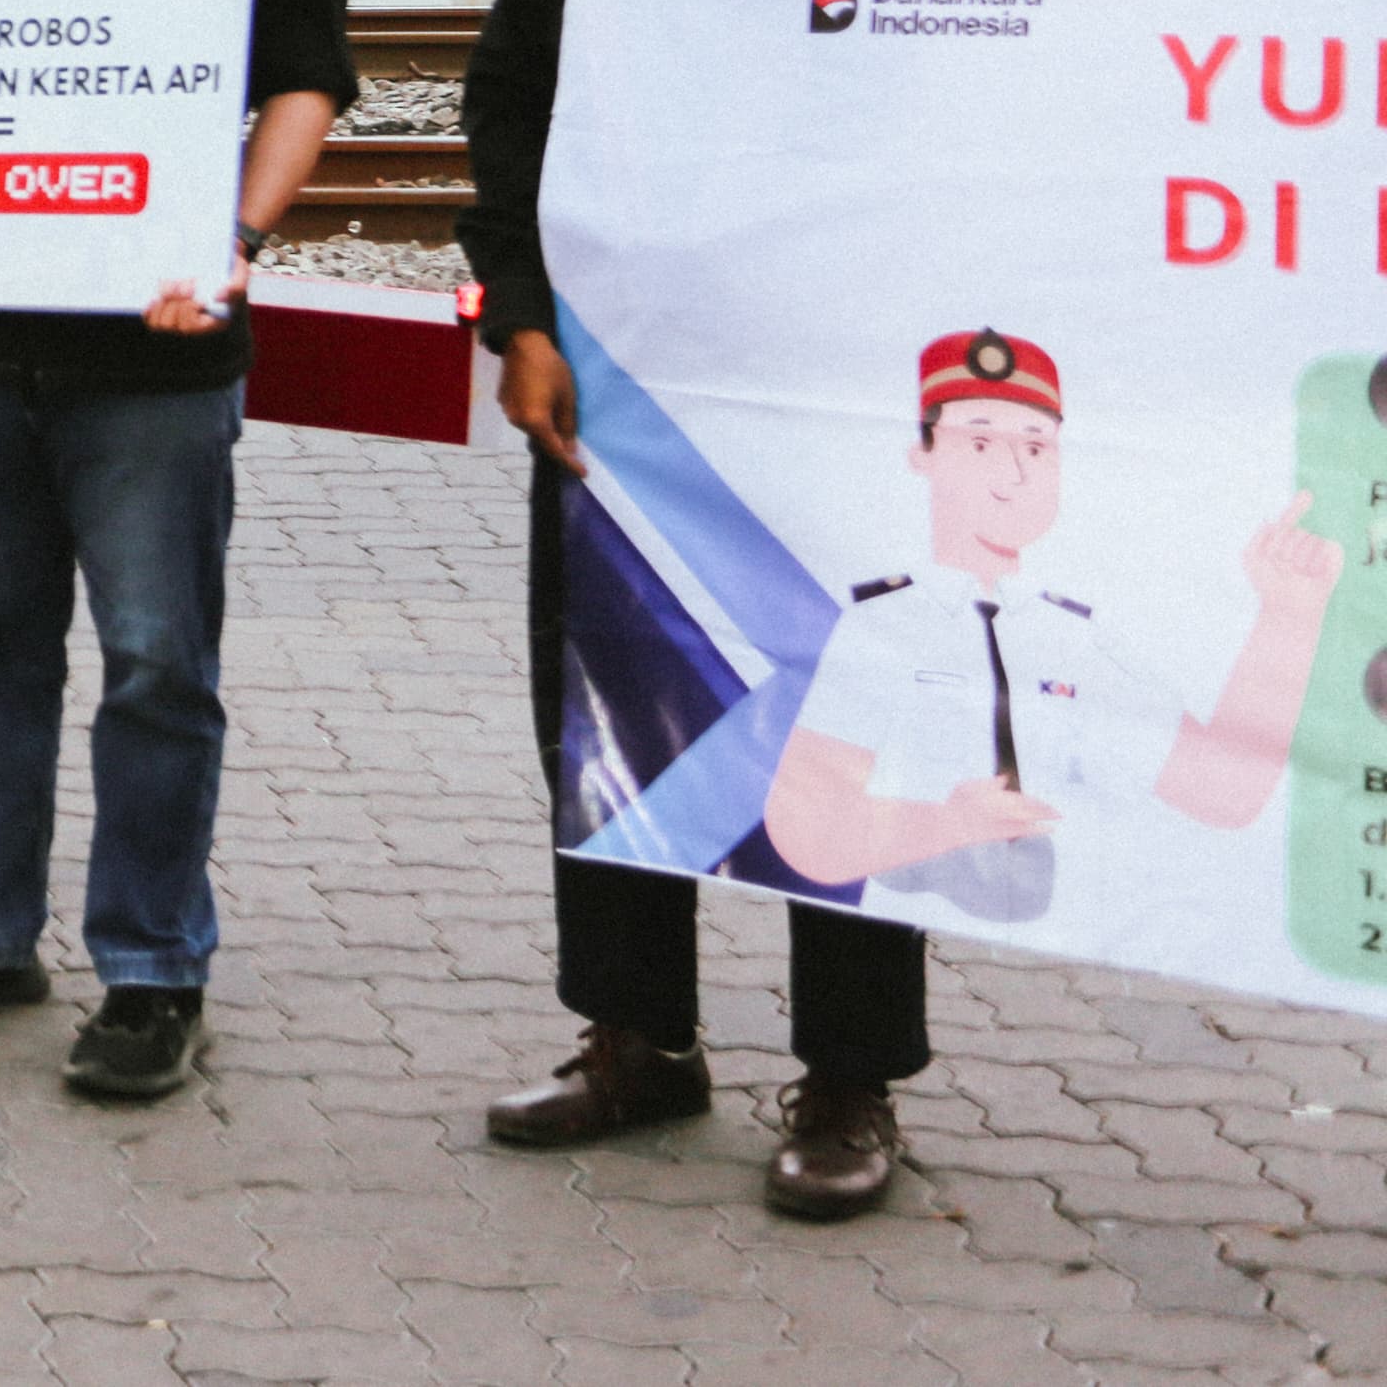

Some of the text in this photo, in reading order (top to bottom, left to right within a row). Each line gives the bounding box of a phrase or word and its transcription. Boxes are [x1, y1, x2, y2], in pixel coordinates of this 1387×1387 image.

[870, 9, 1030, 37] Indonesia
[30, 65, 154, 96] KERETA
[165, 63, 221, 94] API
[1162, 34, 1387, 129] YU
[6, 164, 136, 200] OVER
[1164, 176, 1300, 273] DI
